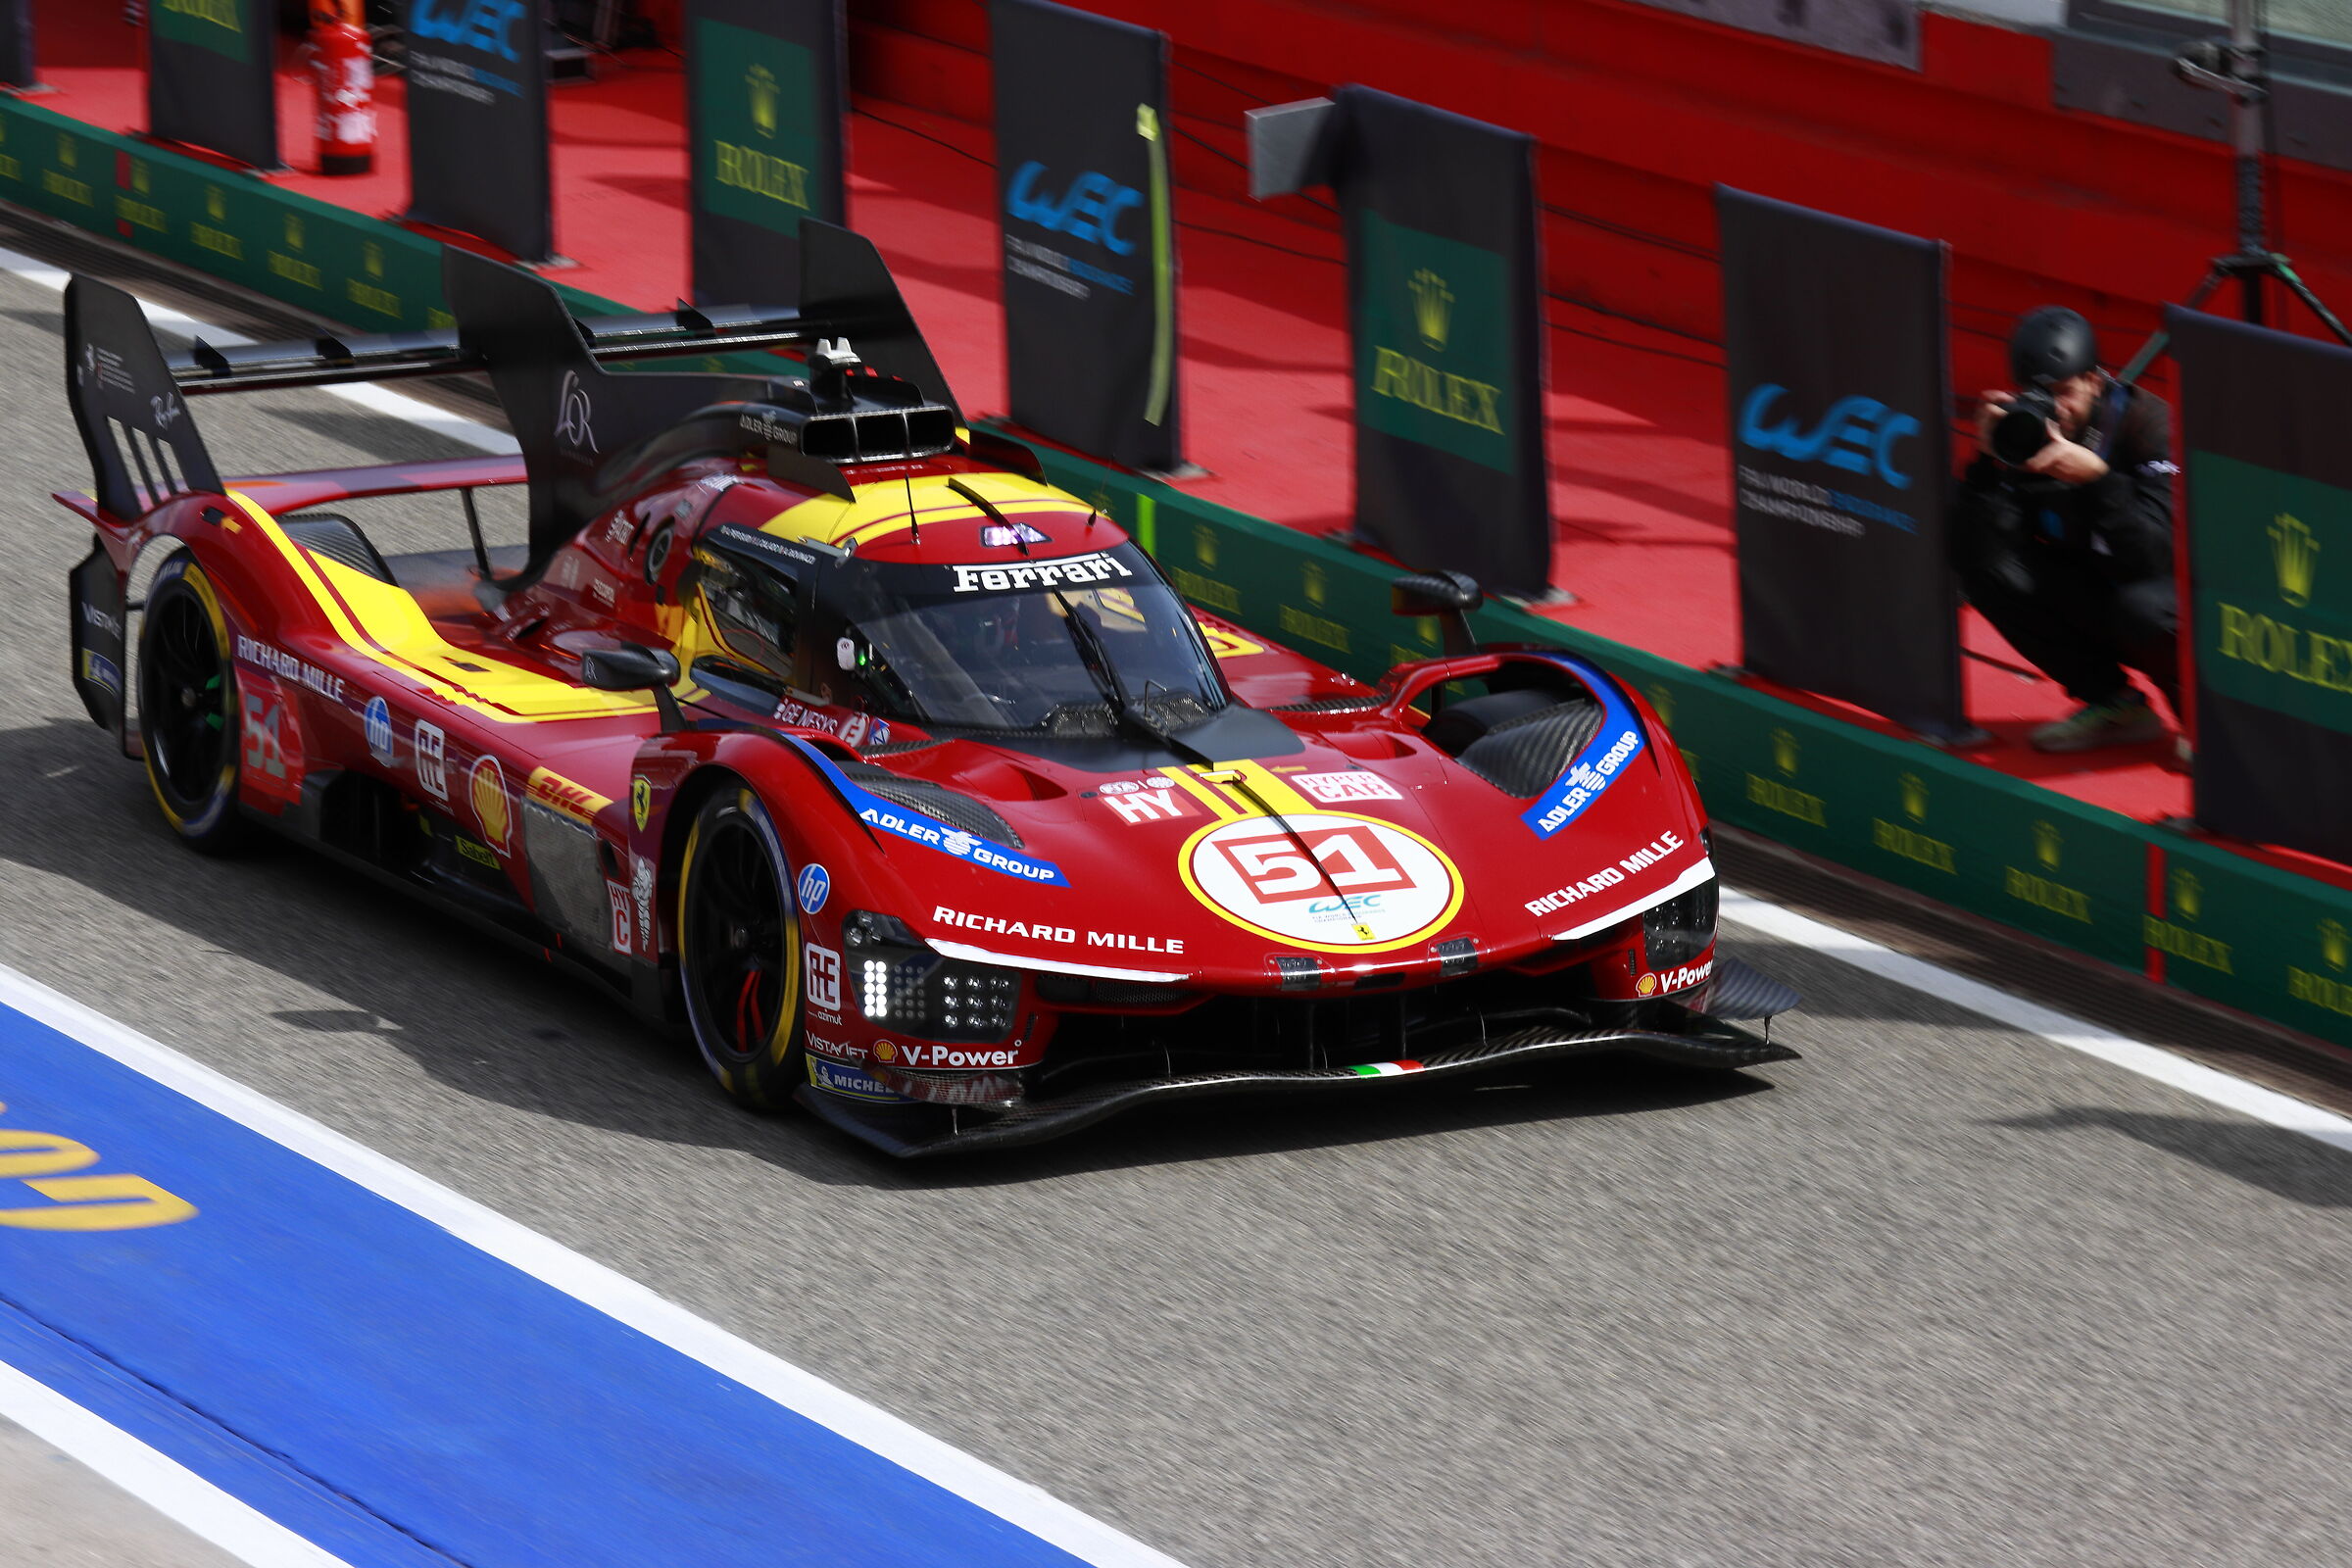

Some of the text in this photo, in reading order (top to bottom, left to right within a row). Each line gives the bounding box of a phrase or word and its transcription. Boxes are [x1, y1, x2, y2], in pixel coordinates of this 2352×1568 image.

[713, 139, 810, 211] ROLEX
[1005, 160, 1145, 257] WEC
[1370, 345, 1505, 436] ROLEX
[1740, 382, 1922, 489] WEC
[954, 551, 1133, 593] Ferrari
[237, 634, 346, 703] RICHARD MILLE
[245, 694, 287, 780] 51
[540, 775, 595, 816] DHL
[1103, 789, 1183, 823] HY
[1295, 771, 1374, 786] HYPER
[1311, 782, 1396, 800] CAR
[1538, 730, 1640, 833] ADLER GROUP
[860, 808, 1055, 881] ADLER GROUP
[1227, 834, 1404, 896] 51
[801, 864, 826, 913] hp
[1524, 830, 1685, 917] RICHARD MILLE
[932, 906, 1184, 955] RICHARD MILLE
[1308, 894, 1381, 914] WEC
[817, 1008, 843, 1025] azimut
[902, 1045, 1019, 1066] V-Power
